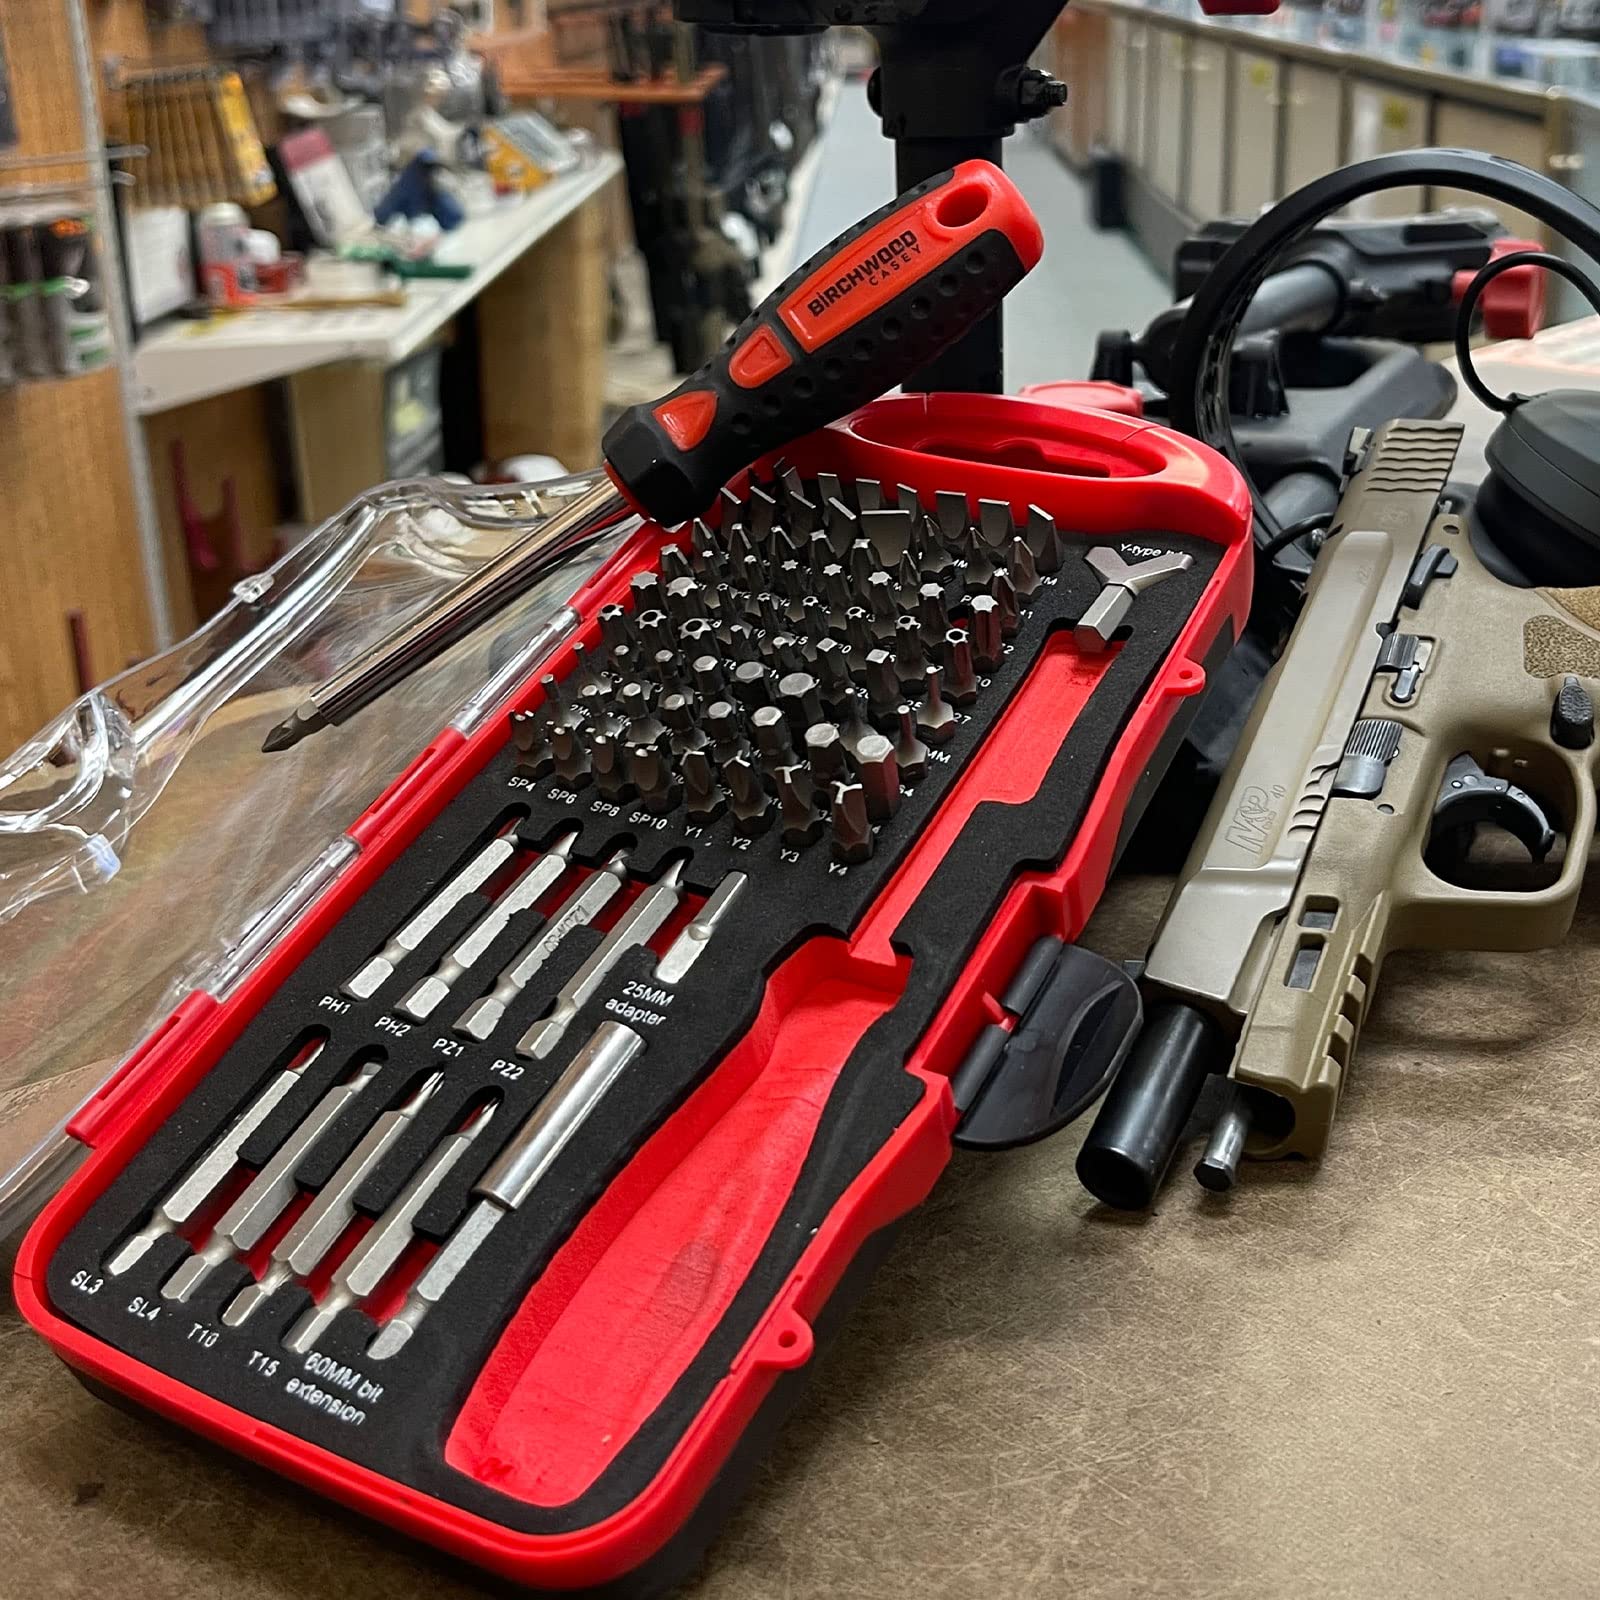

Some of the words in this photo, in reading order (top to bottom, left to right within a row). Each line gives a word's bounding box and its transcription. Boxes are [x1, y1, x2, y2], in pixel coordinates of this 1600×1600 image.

[807, 230, 917, 317] BIRCHWOOD
[869, 244, 921, 286] CASEY
[1121, 543, 1161, 557] Y-type
[508, 776, 536, 792] SP4
[548, 788, 578, 804] SP6
[590, 801, 620, 817] SP8
[629, 811, 668, 831] SP10
[684, 825, 702, 839] Y1
[731, 836, 752, 850] Y2
[779, 848, 800, 863] Y3
[828, 862, 848, 877] Y4
[318, 995, 351, 1015] PH1
[622, 981, 674, 1008] 25MM
[604, 997, 666, 1026] adapter
[374, 1016, 411, 1037] PH2
[433, 1038, 465, 1058] PZ1
[490, 1060, 525, 1081] PZ2
[70, 1270, 104, 1295] SL3
[127, 1296, 161, 1321] SL4
[188, 1323, 220, 1348] T10
[248, 1350, 281, 1377] T15
[304, 1351, 363, 1391] 60MM
[357, 1382, 385, 1404] bit
[286, 1377, 366, 1426] extension
